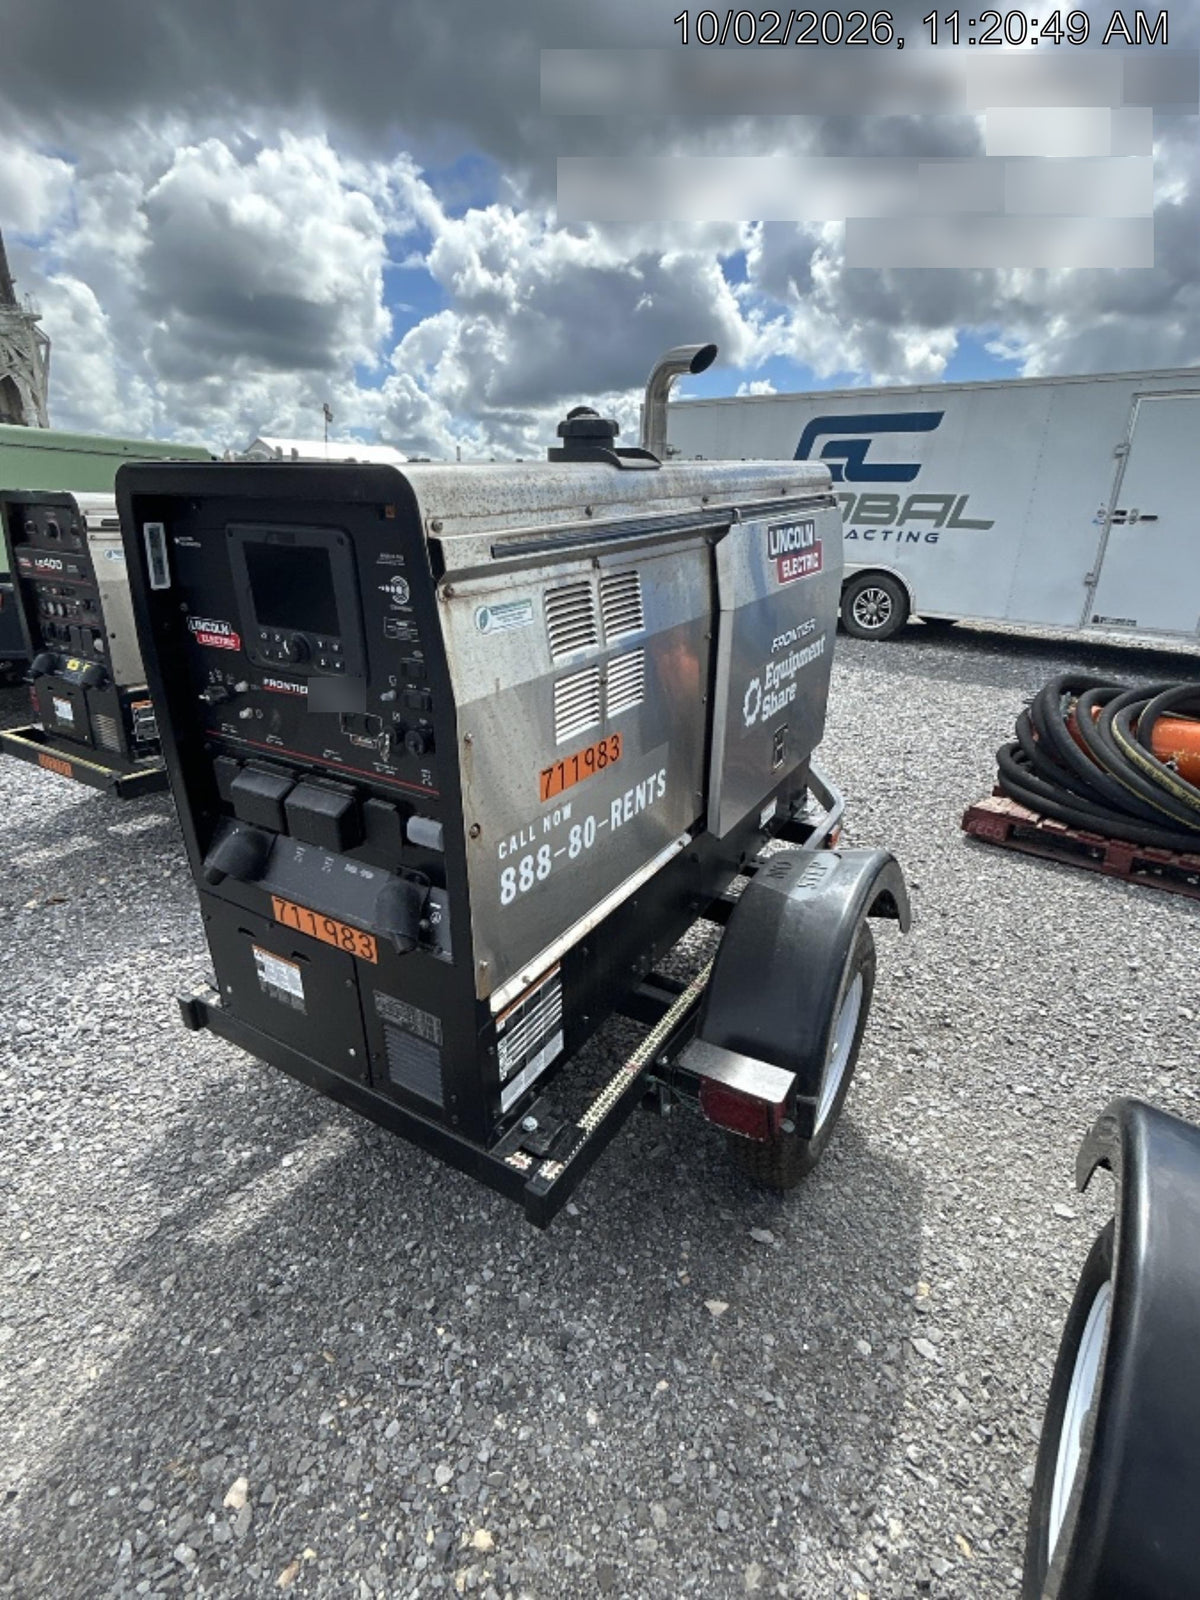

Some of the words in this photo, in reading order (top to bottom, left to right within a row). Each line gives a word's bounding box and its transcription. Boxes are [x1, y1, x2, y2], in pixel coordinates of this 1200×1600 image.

[769, 523, 814, 556] LINCOLN
[844, 528, 941, 544] ACTING
[782, 552, 819, 579] ELECTRIC
[190, 619, 230, 636] LINCOLN
[771, 618, 816, 653] FRONTIER
[764, 632, 826, 690] Equipment
[761, 682, 798, 722] Share
[542, 734, 620, 800] 711983
[498, 825, 536, 860] CALL
[543, 802, 572, 834] NOW
[500, 768, 667, 906] 888-80-RENTS
[275, 898, 374, 960] 711983
